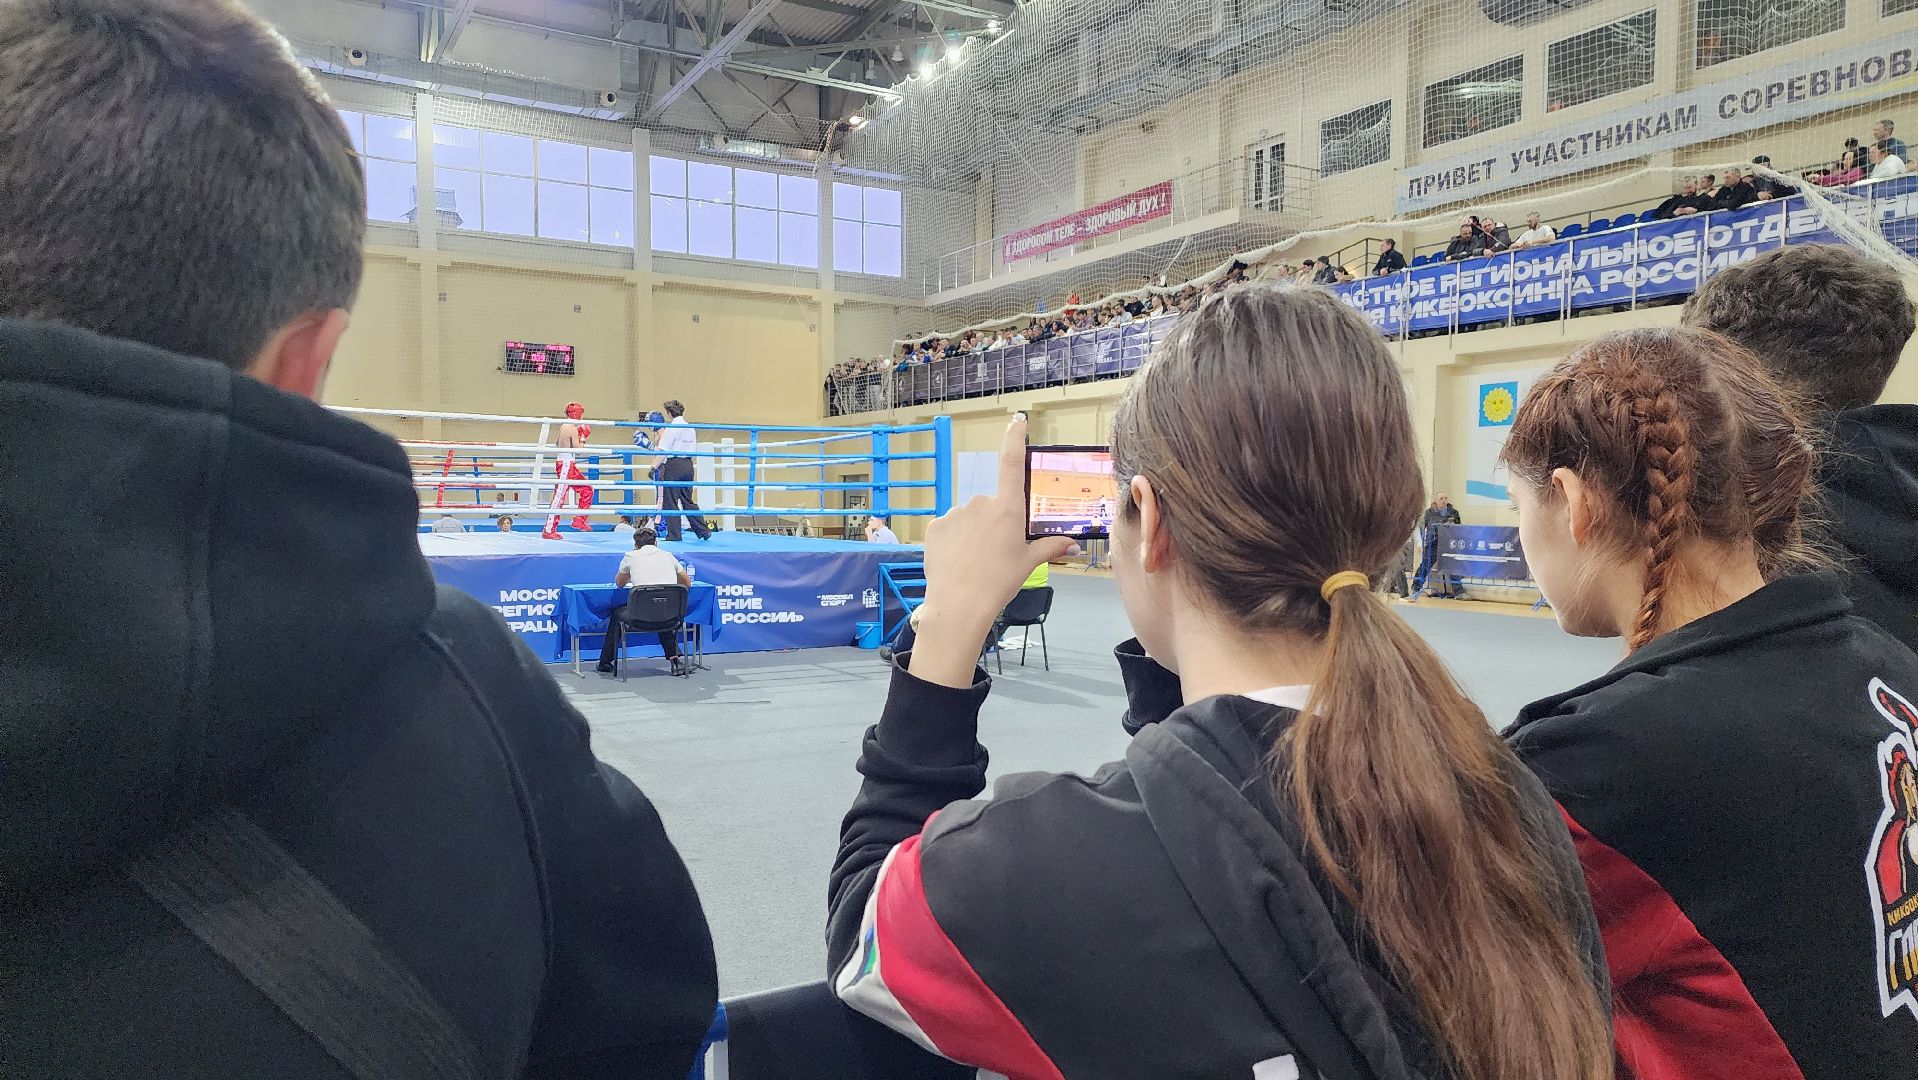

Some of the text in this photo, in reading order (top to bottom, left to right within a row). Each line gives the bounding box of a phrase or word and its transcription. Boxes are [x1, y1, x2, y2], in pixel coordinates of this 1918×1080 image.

[1408, 48, 1918, 199] ПРИВЕТ УЧАСТНИКАМ СОРЕВНОВ
[1086, 199, 1137, 233] ЗДОРОВЫЙ
[1440, 225, 1695, 293] РЕГИОНАЛЬНОЕ
[1390, 275, 1595, 324] КИКБОКСИНГА
[500, 588, 561, 602] МОСК
